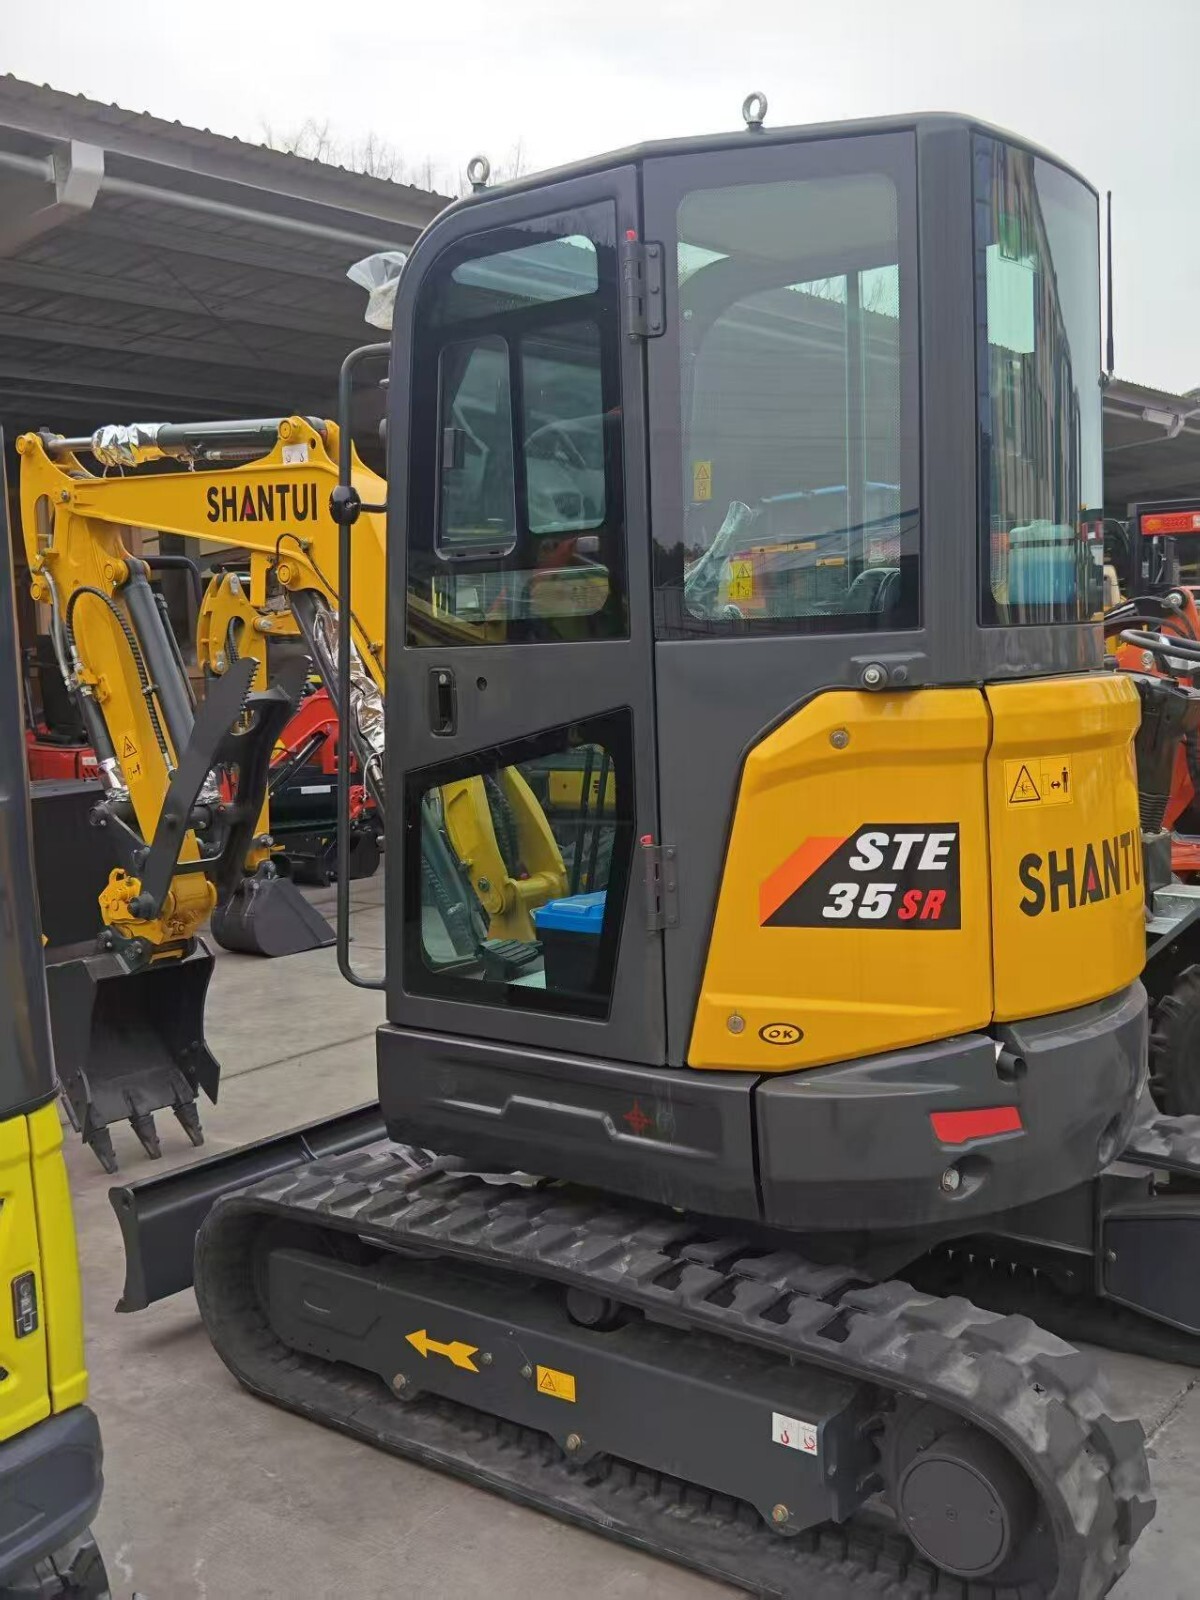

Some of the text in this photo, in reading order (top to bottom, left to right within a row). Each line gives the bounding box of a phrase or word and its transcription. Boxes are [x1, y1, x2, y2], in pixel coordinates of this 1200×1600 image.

[206, 483, 318, 522] SHANTUI
[848, 831, 956, 872] STE
[1018, 826, 1140, 917] SHANTU
[769, 1029, 793, 1039] OK
